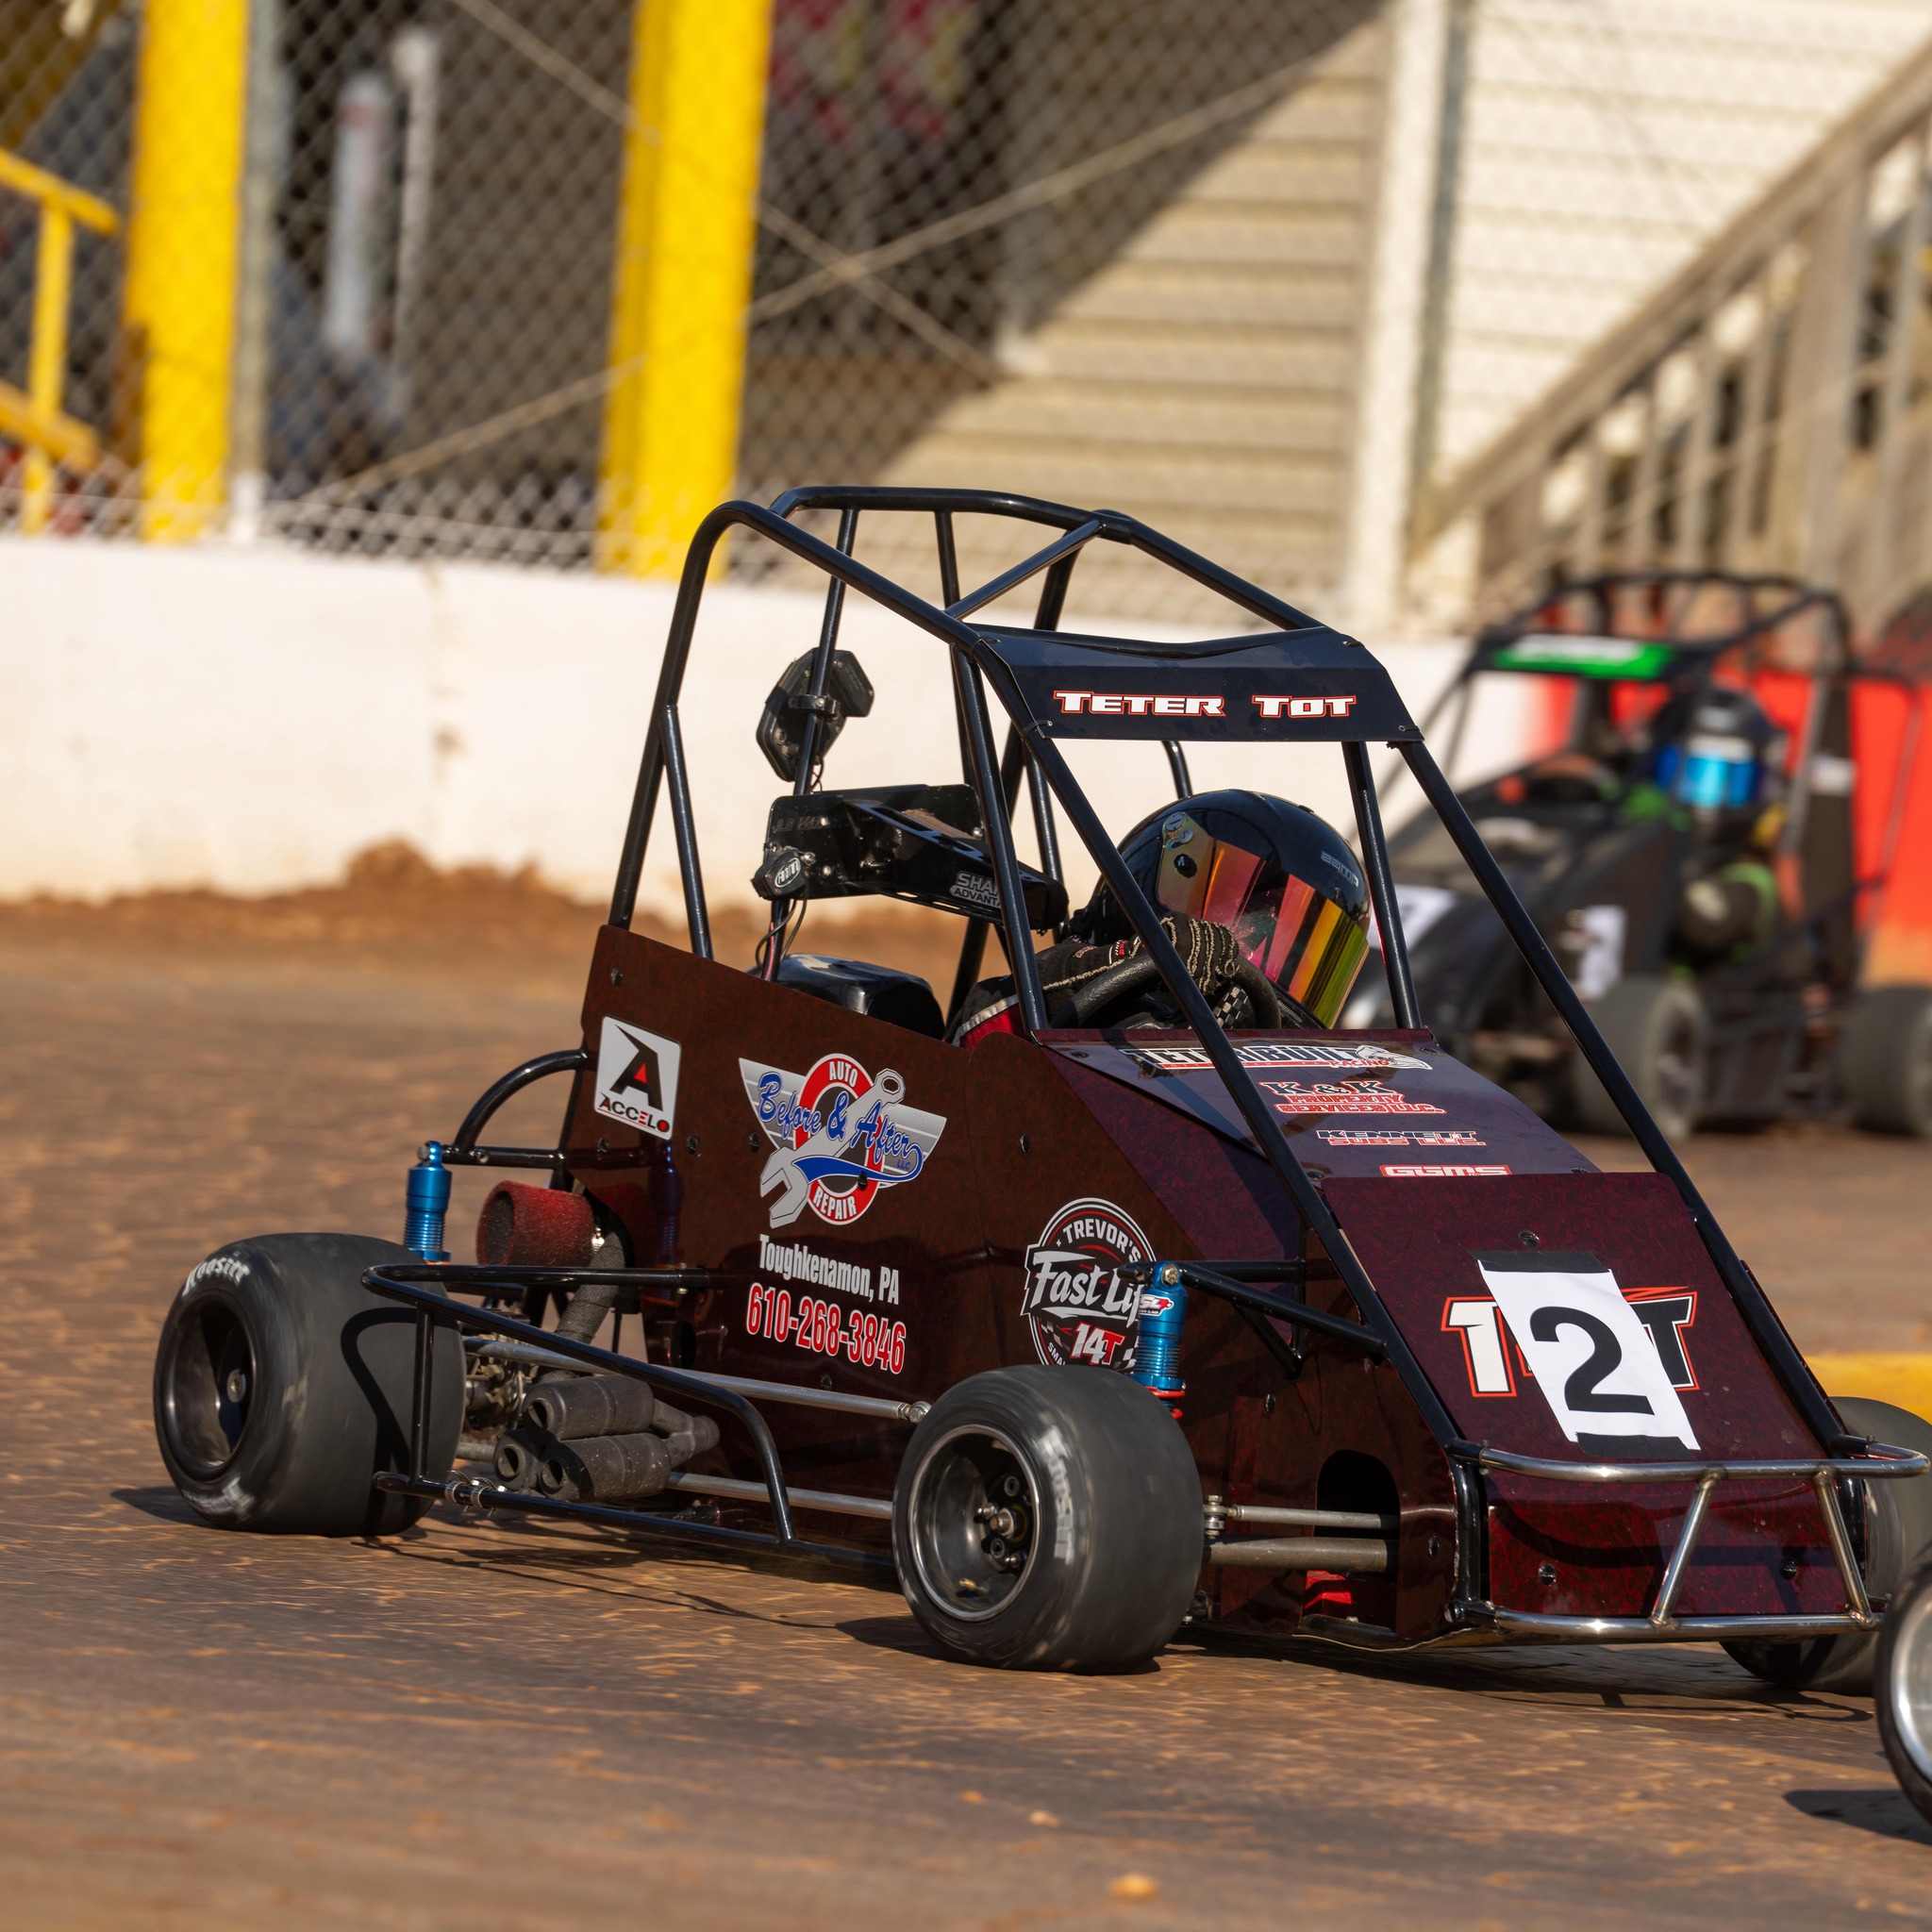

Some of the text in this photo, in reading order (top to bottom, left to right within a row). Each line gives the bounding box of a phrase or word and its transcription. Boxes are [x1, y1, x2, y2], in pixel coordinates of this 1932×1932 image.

[1054, 690, 1356, 718] TETER TOT
[954, 887, 1000, 907] ADVANT
[957, 872, 998, 895] SHA
[829, 1060, 858, 1088] AUTO
[1258, 1081, 1400, 1095] K & K
[599, 1092, 671, 1133] ACCELO
[1274, 1103, 1388, 1113] SERVICES
[1285, 1093, 1406, 1104] PROPERTY
[758, 1072, 912, 1165] Before & After
[897, 1158, 911, 1171] LLC
[812, 1185, 857, 1221] REPAIR
[1062, 1218, 1142, 1263] TREVOR'S
[759, 1234, 899, 1305] Toughkenamon, PA
[1030, 1251, 1109, 1309] Fast
[746, 1282, 907, 1374] 610-268-3846
[1069, 1321, 1126, 1365] 14T
[1529, 1306, 1656, 1416] 2
